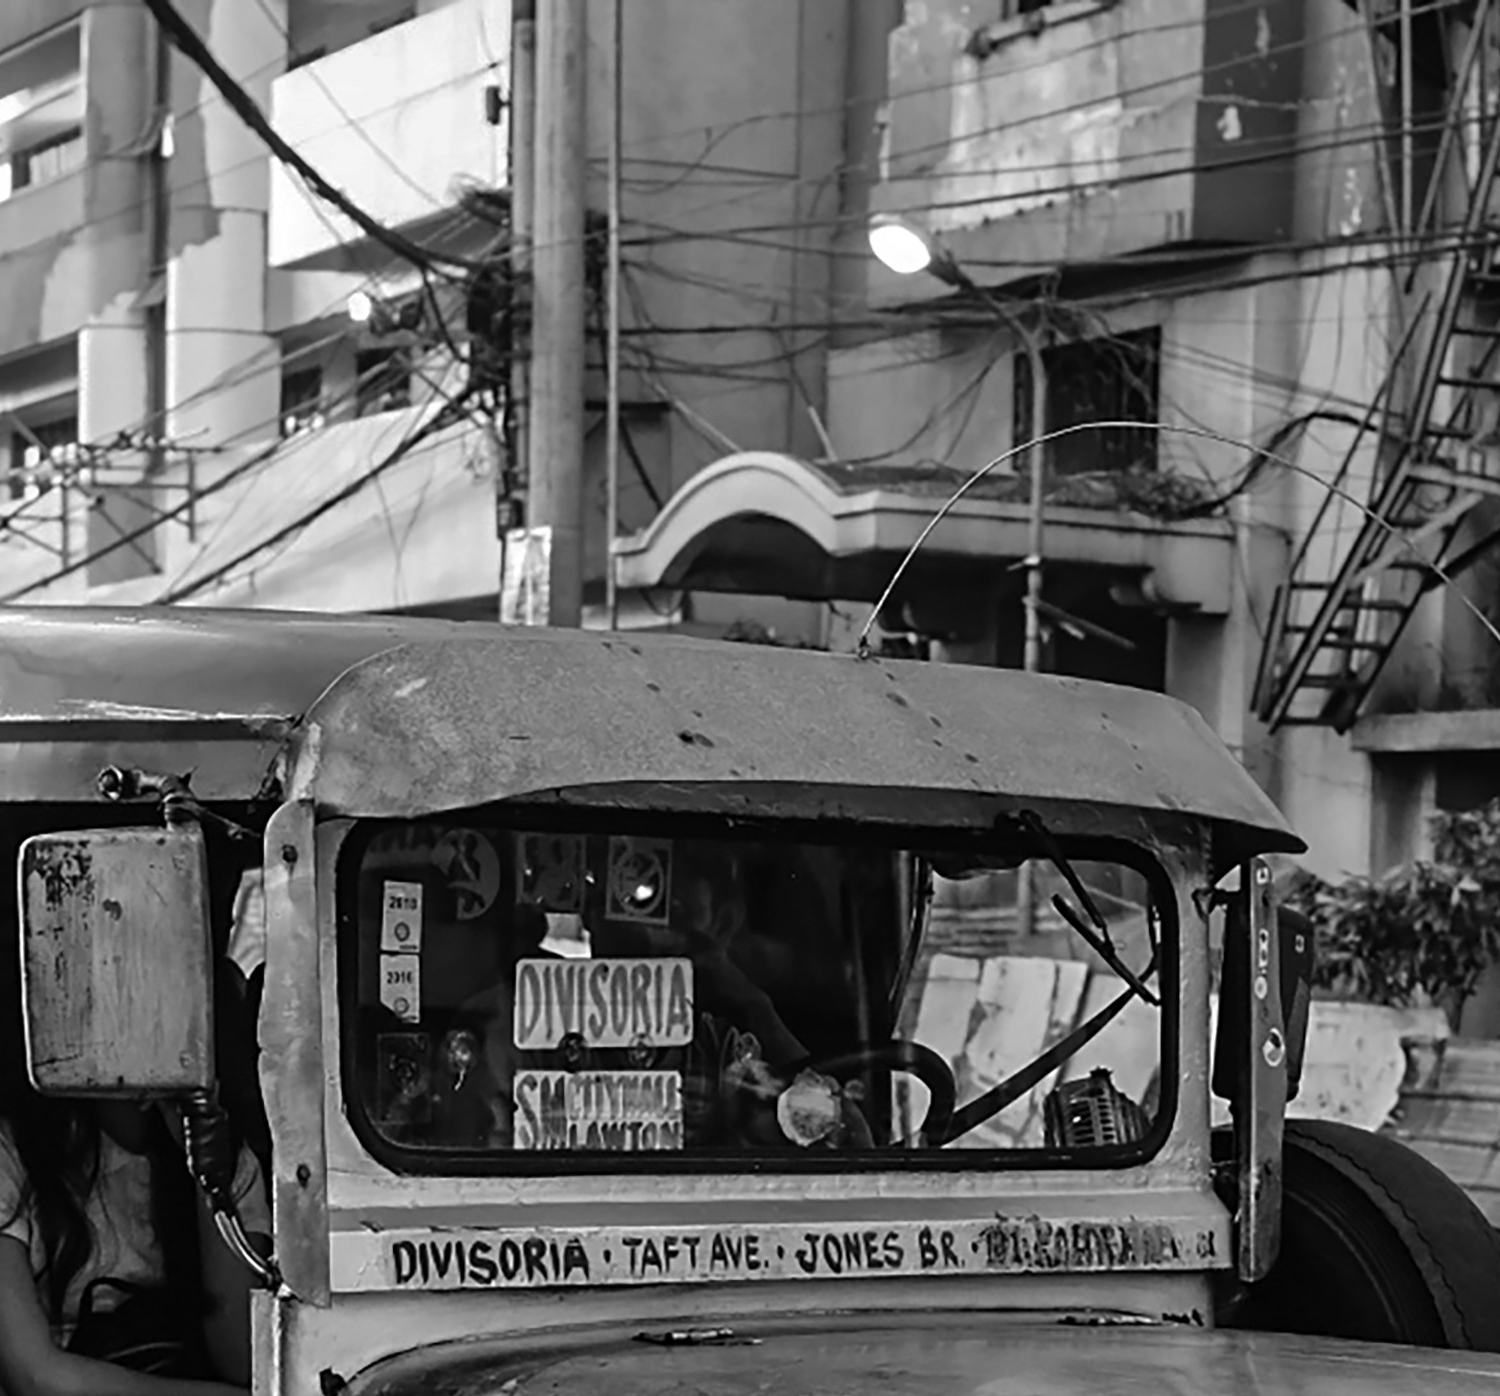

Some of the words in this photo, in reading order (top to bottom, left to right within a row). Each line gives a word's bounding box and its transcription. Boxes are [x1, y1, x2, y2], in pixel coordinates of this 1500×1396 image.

[518, 963, 690, 1044] DIVISORIA
[392, 1237, 590, 1285] DIVISORIA
[621, 1235, 701, 1276] TAFT
[710, 1232, 771, 1273] AVE.
[794, 1230, 904, 1274] JONES
[918, 1226, 966, 1269] BR.
